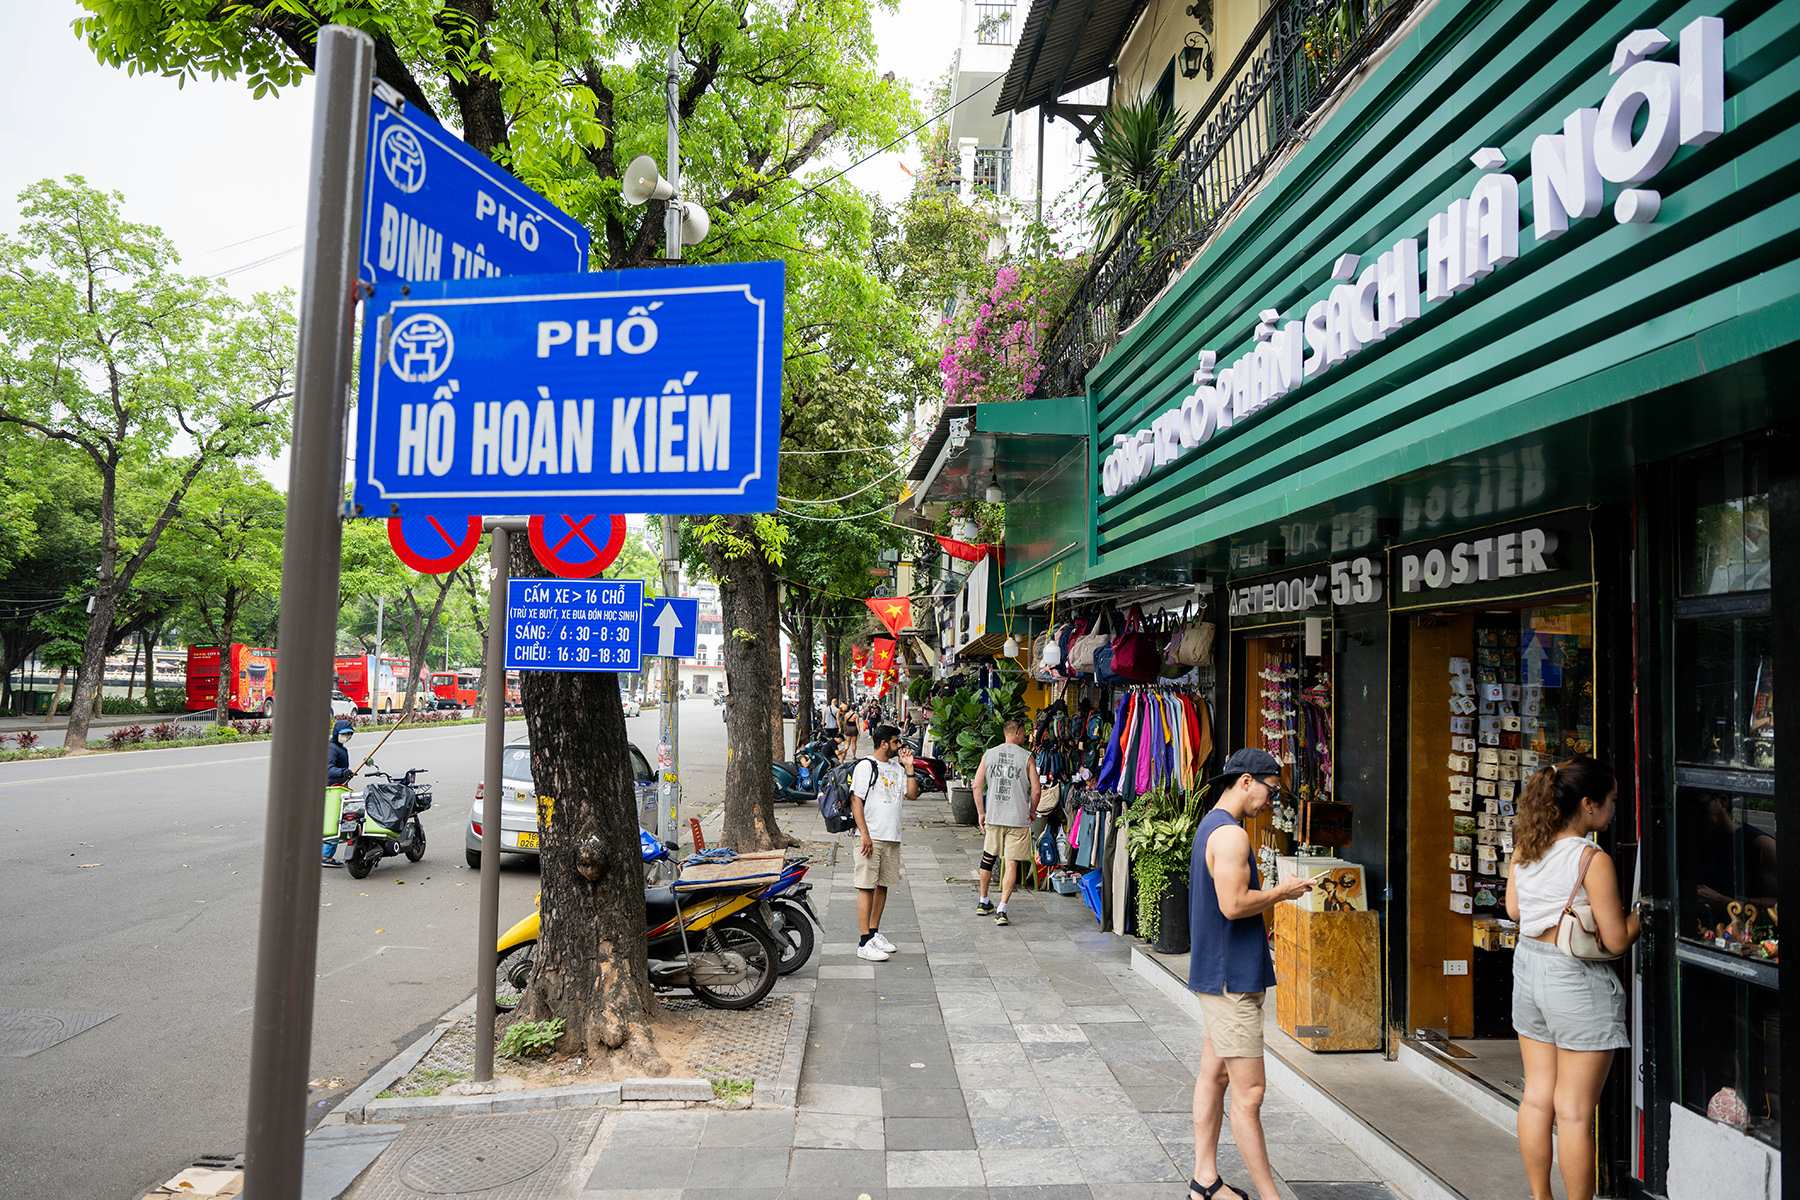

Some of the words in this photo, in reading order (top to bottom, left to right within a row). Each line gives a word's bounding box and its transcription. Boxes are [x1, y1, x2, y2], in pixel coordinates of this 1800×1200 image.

[379, 202, 444, 281] ĐINH
[476, 189, 543, 252] PHỐ
[1103, 429, 1154, 497] CÔNG
[1152, 408, 1181, 468] TY
[1180, 350, 1217, 449] CỔ
[1216, 308, 1304, 430] PHẦN
[1303, 253, 1421, 377] SÁCH
[1427, 147, 1519, 303] HÀ
[1531, 15, 1724, 241] NỘI
[537, 301, 664, 358] PHỐ
[398, 379, 459, 476] HỒ
[471, 386, 594, 477] HOÀN
[611, 371, 732, 474] KIẾM
[1229, 574, 1327, 616] ARTBOOK
[1331, 556, 1382, 605] 53
[1402, 528, 1559, 593] POSTER
[510, 605, 527, 619] (TRỪ
[528, 608, 538, 618] XE
[561, 609, 571, 619] XE
[572, 608, 587, 620] ĐƯA
[587, 607, 602, 621] ĐÓN
[602, 610, 618, 623] HỌC
[618, 610, 639, 622] SINH)
[524, 583, 550, 603] CẤM
[554, 589, 570, 603] XE
[585, 589, 597, 604] 16
[602, 584, 625, 605] CHỖ
[514, 641, 551, 661] CHIỀU:
[515, 622, 551, 640] SÁNG:
